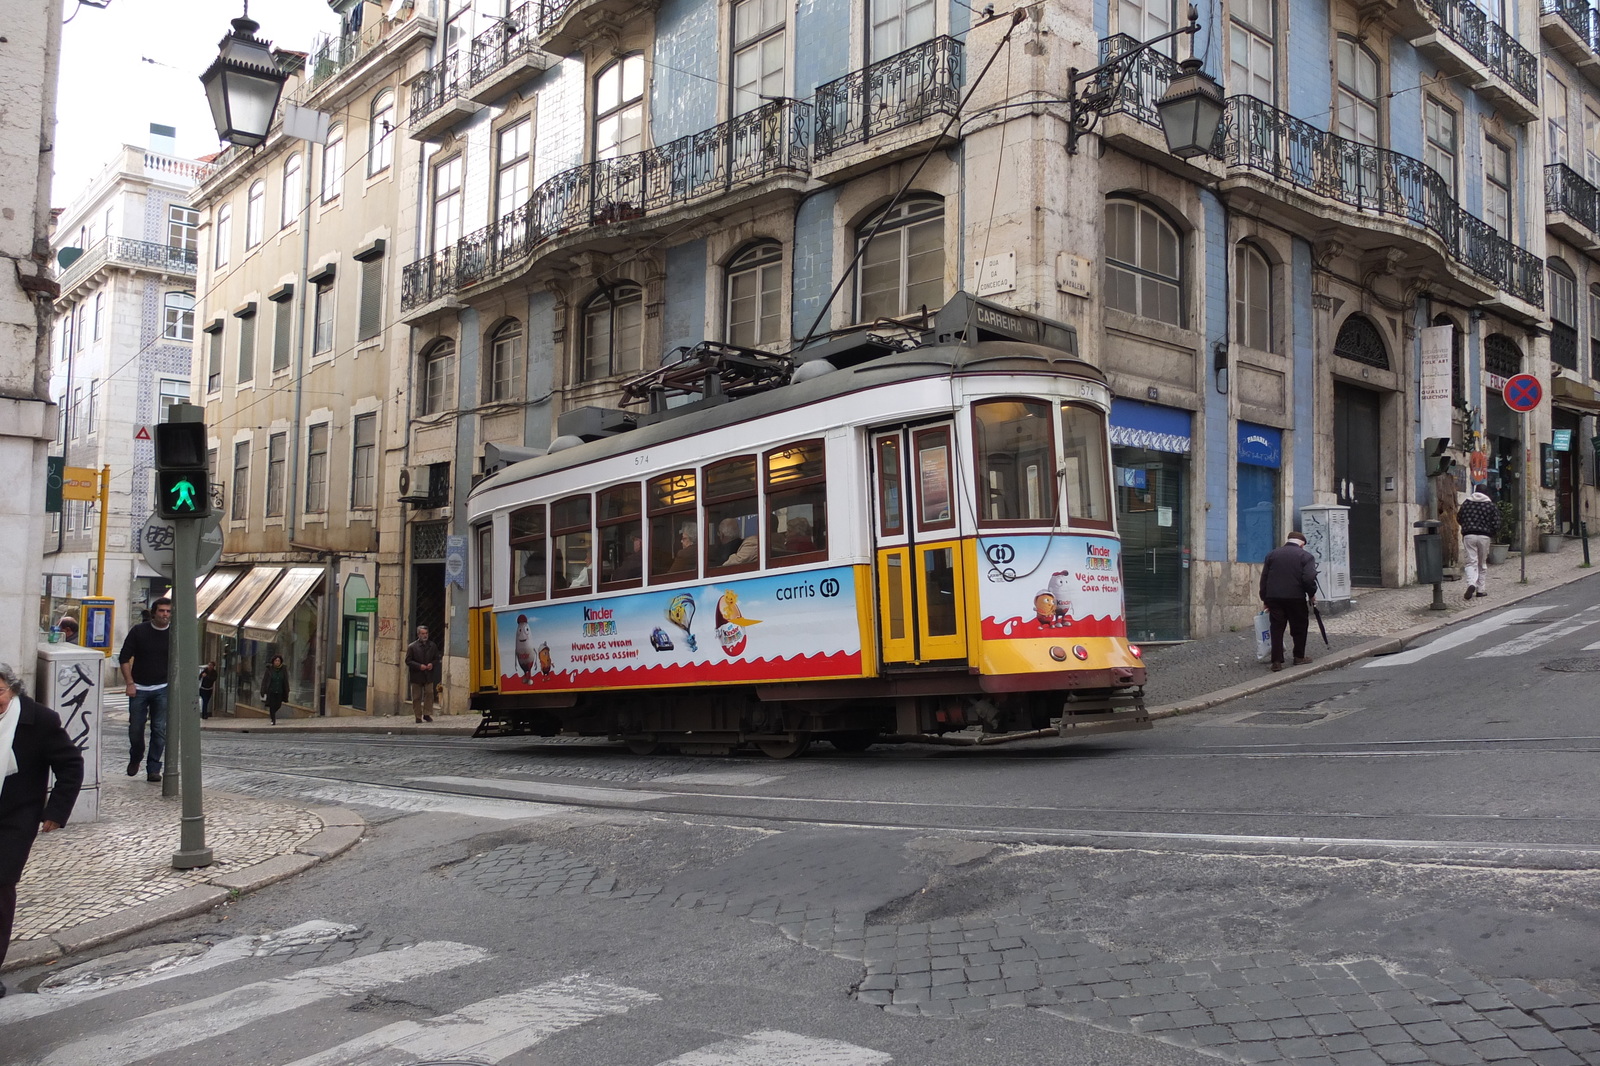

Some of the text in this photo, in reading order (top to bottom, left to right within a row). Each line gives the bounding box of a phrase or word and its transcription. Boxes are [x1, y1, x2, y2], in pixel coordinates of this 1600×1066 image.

[990, 270, 997, 278] DA
[1071, 270, 1077, 278] DA
[977, 308, 1022, 333] CARREIRA
[635, 455, 649, 466] 574
[1075, 572, 1095, 584] Veja
[776, 580, 815, 601] carris
[571, 638, 632, 651] Nunca se viram
[571, 649, 639, 664] surpresas assim!
